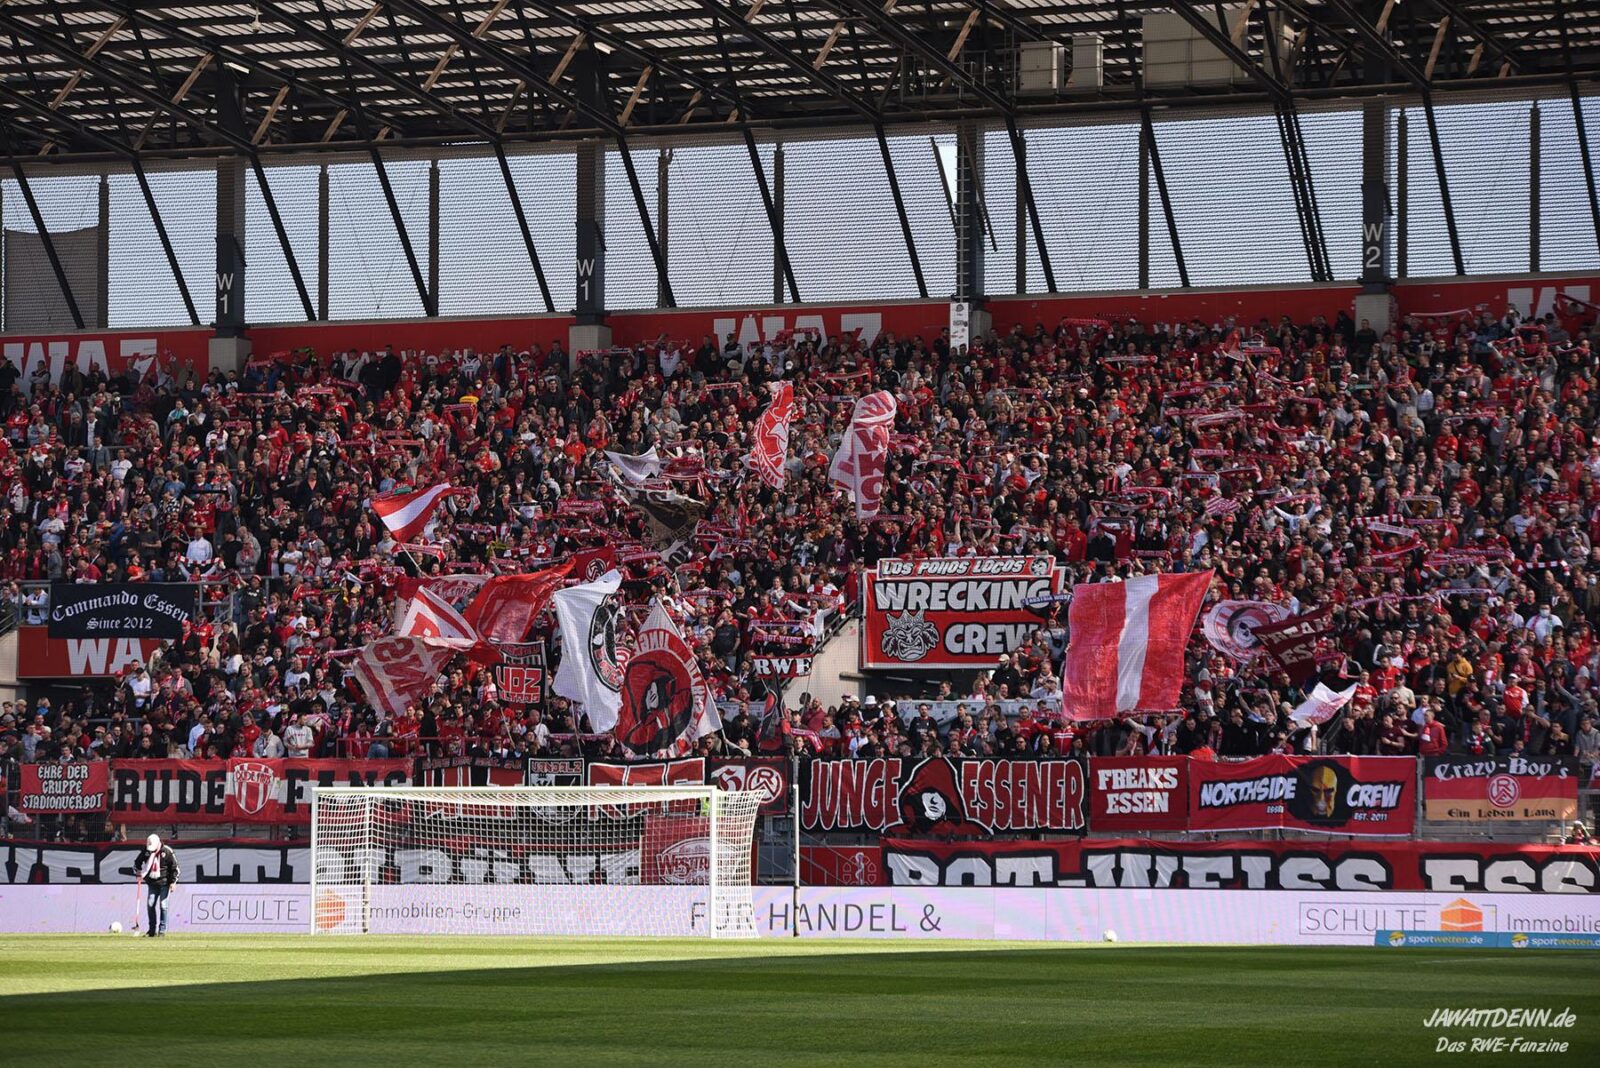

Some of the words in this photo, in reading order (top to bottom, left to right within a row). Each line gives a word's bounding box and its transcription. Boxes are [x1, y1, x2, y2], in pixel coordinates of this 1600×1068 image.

[1364, 223, 1383, 242] W
[577, 258, 595, 276] W
[1366, 246, 1380, 268] 2
[216, 273, 234, 291] W
[580, 281, 590, 301] 1
[219, 294, 230, 314] 1
[882, 561, 913, 575] LOS
[52, 591, 138, 621] Commando
[144, 594, 188, 621] Essen
[875, 580, 1050, 611] WRECKING
[86, 617, 121, 630] Since
[123, 617, 153, 629] 2012
[945, 624, 1038, 653] CREW
[753, 657, 812, 675] RWE
[38, 764, 63, 779] EHRE
[67, 764, 89, 779] DER
[1098, 767, 1178, 790] FREAKS
[114, 769, 225, 813] RUDE
[801, 758, 902, 831] JUNGE
[960, 759, 1085, 830] ESSENER
[1201, 776, 1297, 806] NORTHSIDE
[1346, 784, 1401, 807] CREW
[1106, 791, 1169, 814] ESSEN
[1478, 808, 1514, 818] Leben
[887, 852, 1387, 890] ROT-WEISS
[197, 900, 299, 921] SCHULTE
[367, 902, 522, 922] mmobilien-Gruppe
[769, 903, 906, 932] HANDEL
[920, 903, 942, 932] &
[1306, 908, 1427, 932] SCHULTE
[1408, 934, 1483, 946] sportwetten.de
